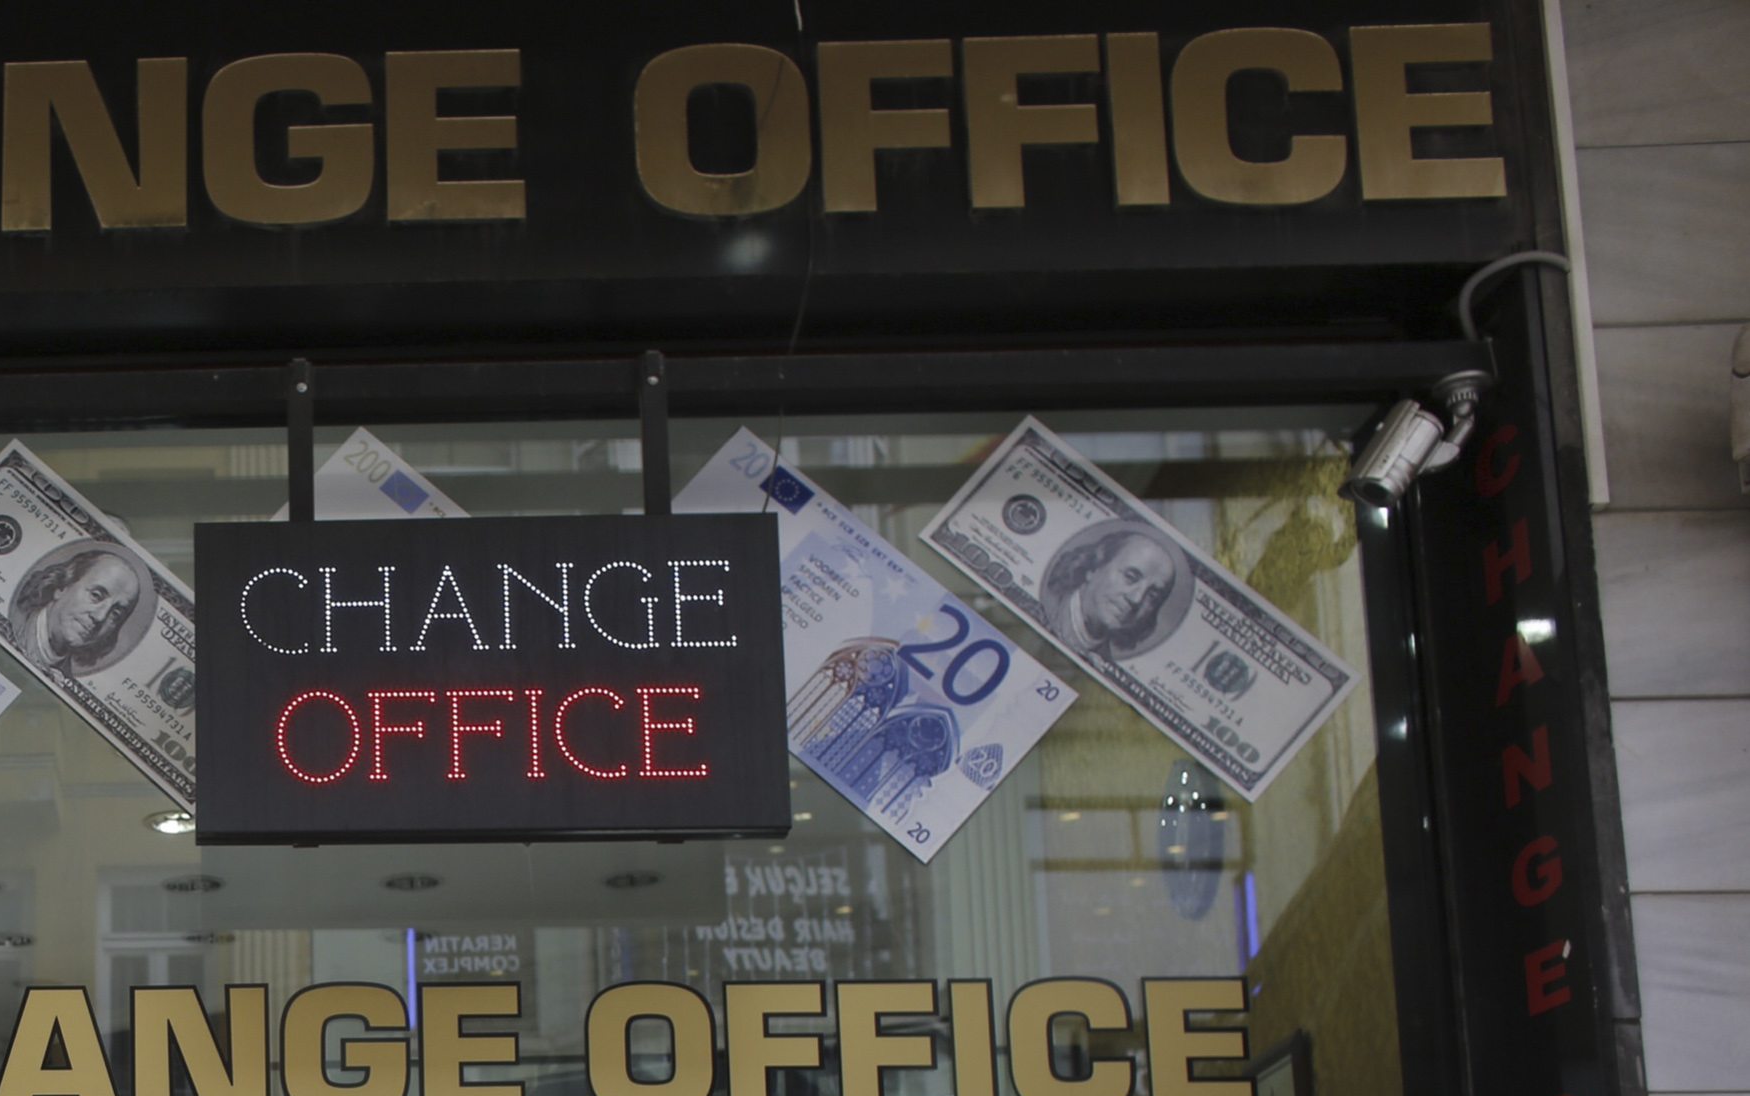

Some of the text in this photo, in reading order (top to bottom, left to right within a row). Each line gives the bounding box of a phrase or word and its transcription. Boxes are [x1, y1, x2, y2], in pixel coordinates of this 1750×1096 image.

[634, 22, 1507, 216] OFFICE
[728, 441, 771, 480] 20
[240, 561, 738, 655] CHANGE
[896, 603, 1011, 706] 20
[277, 687, 709, 783] OFFICE
[1036, 679, 1060, 702] 20
[1475, 424, 1572, 1017] CHANGE
[1202, 715, 1261, 764] 100
[907, 821, 931, 844] 20
